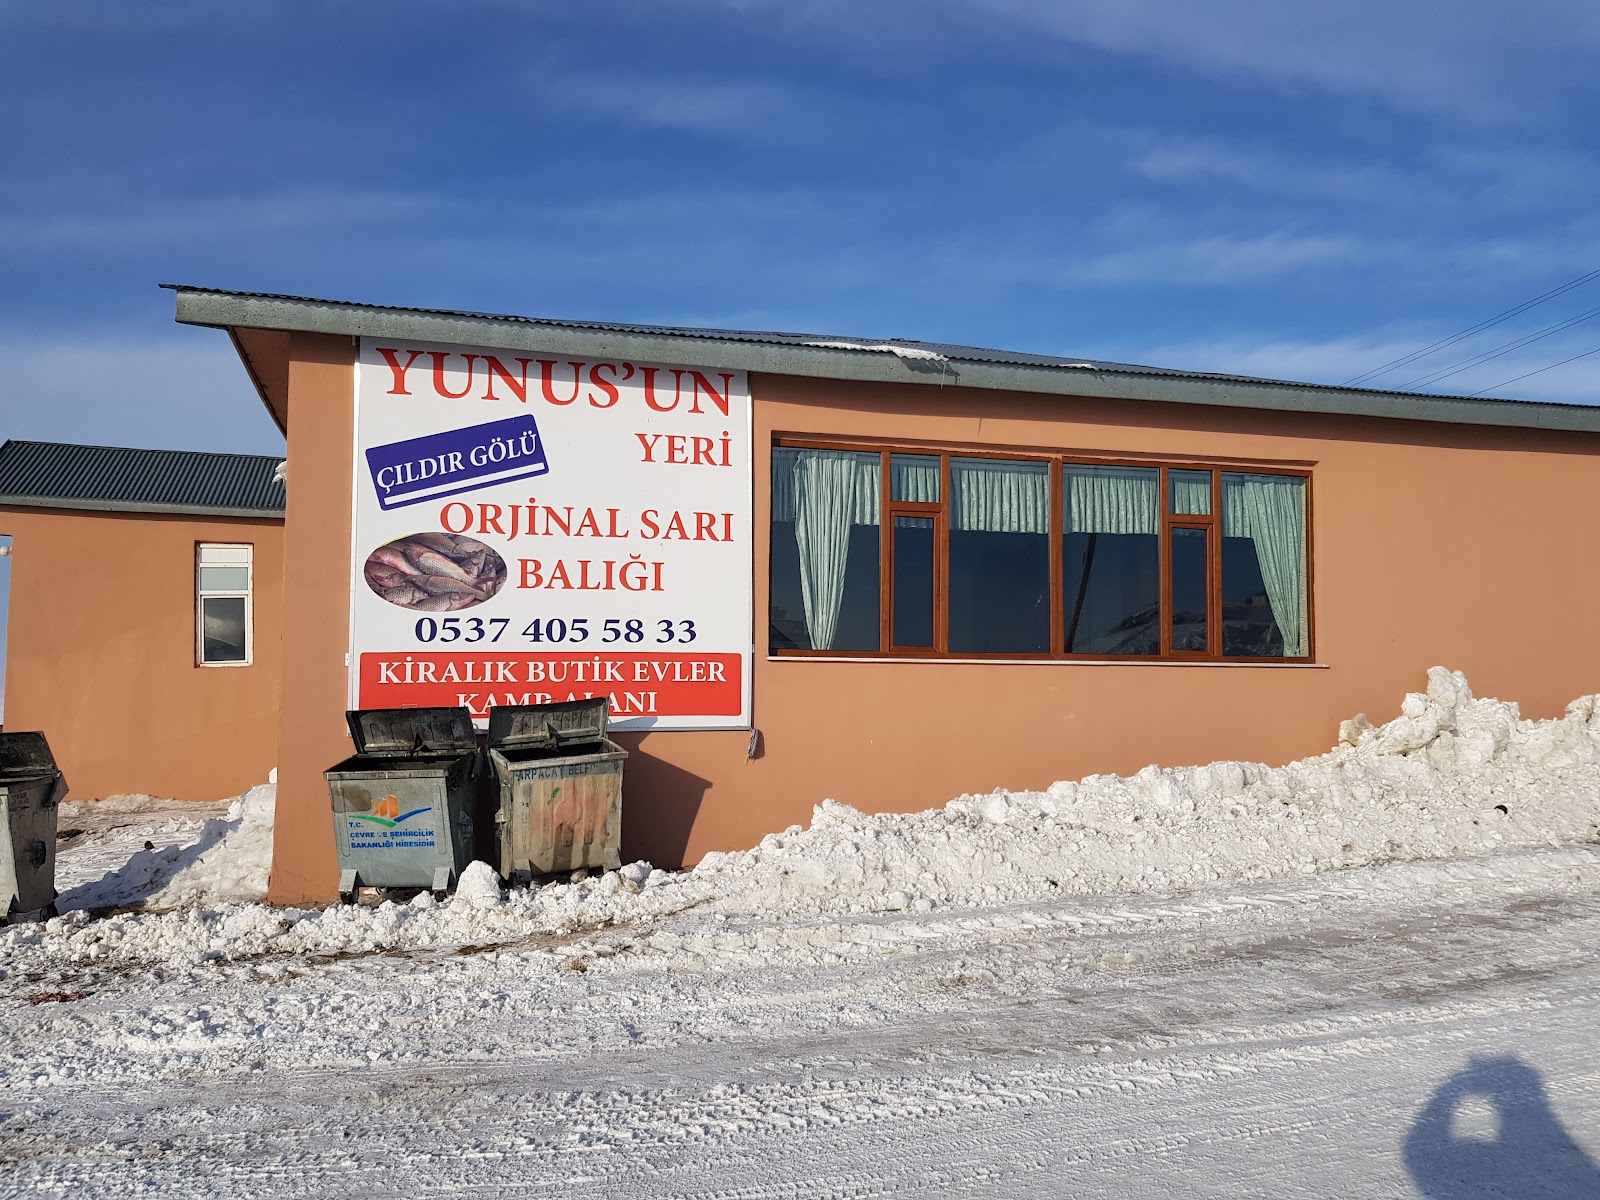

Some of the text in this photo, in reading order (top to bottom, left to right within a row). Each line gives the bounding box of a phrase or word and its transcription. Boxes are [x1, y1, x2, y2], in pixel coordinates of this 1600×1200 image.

[376, 430, 538, 494] ÇILDIR GÖLÜ
[634, 431, 733, 467] YERİ
[440, 497, 734, 542] ORJİNAL SARI
[516, 553, 665, 592] BALIĞI
[414, 617, 697, 644] 0537 405 58 33
[377, 655, 727, 685] KİRALIK BUTİK EVLER
[348, 821, 364, 829] T.C.
[389, 828, 434, 840] ŞEHİRCİLİK
[351, 840, 394, 849] BAKANLIĞI
